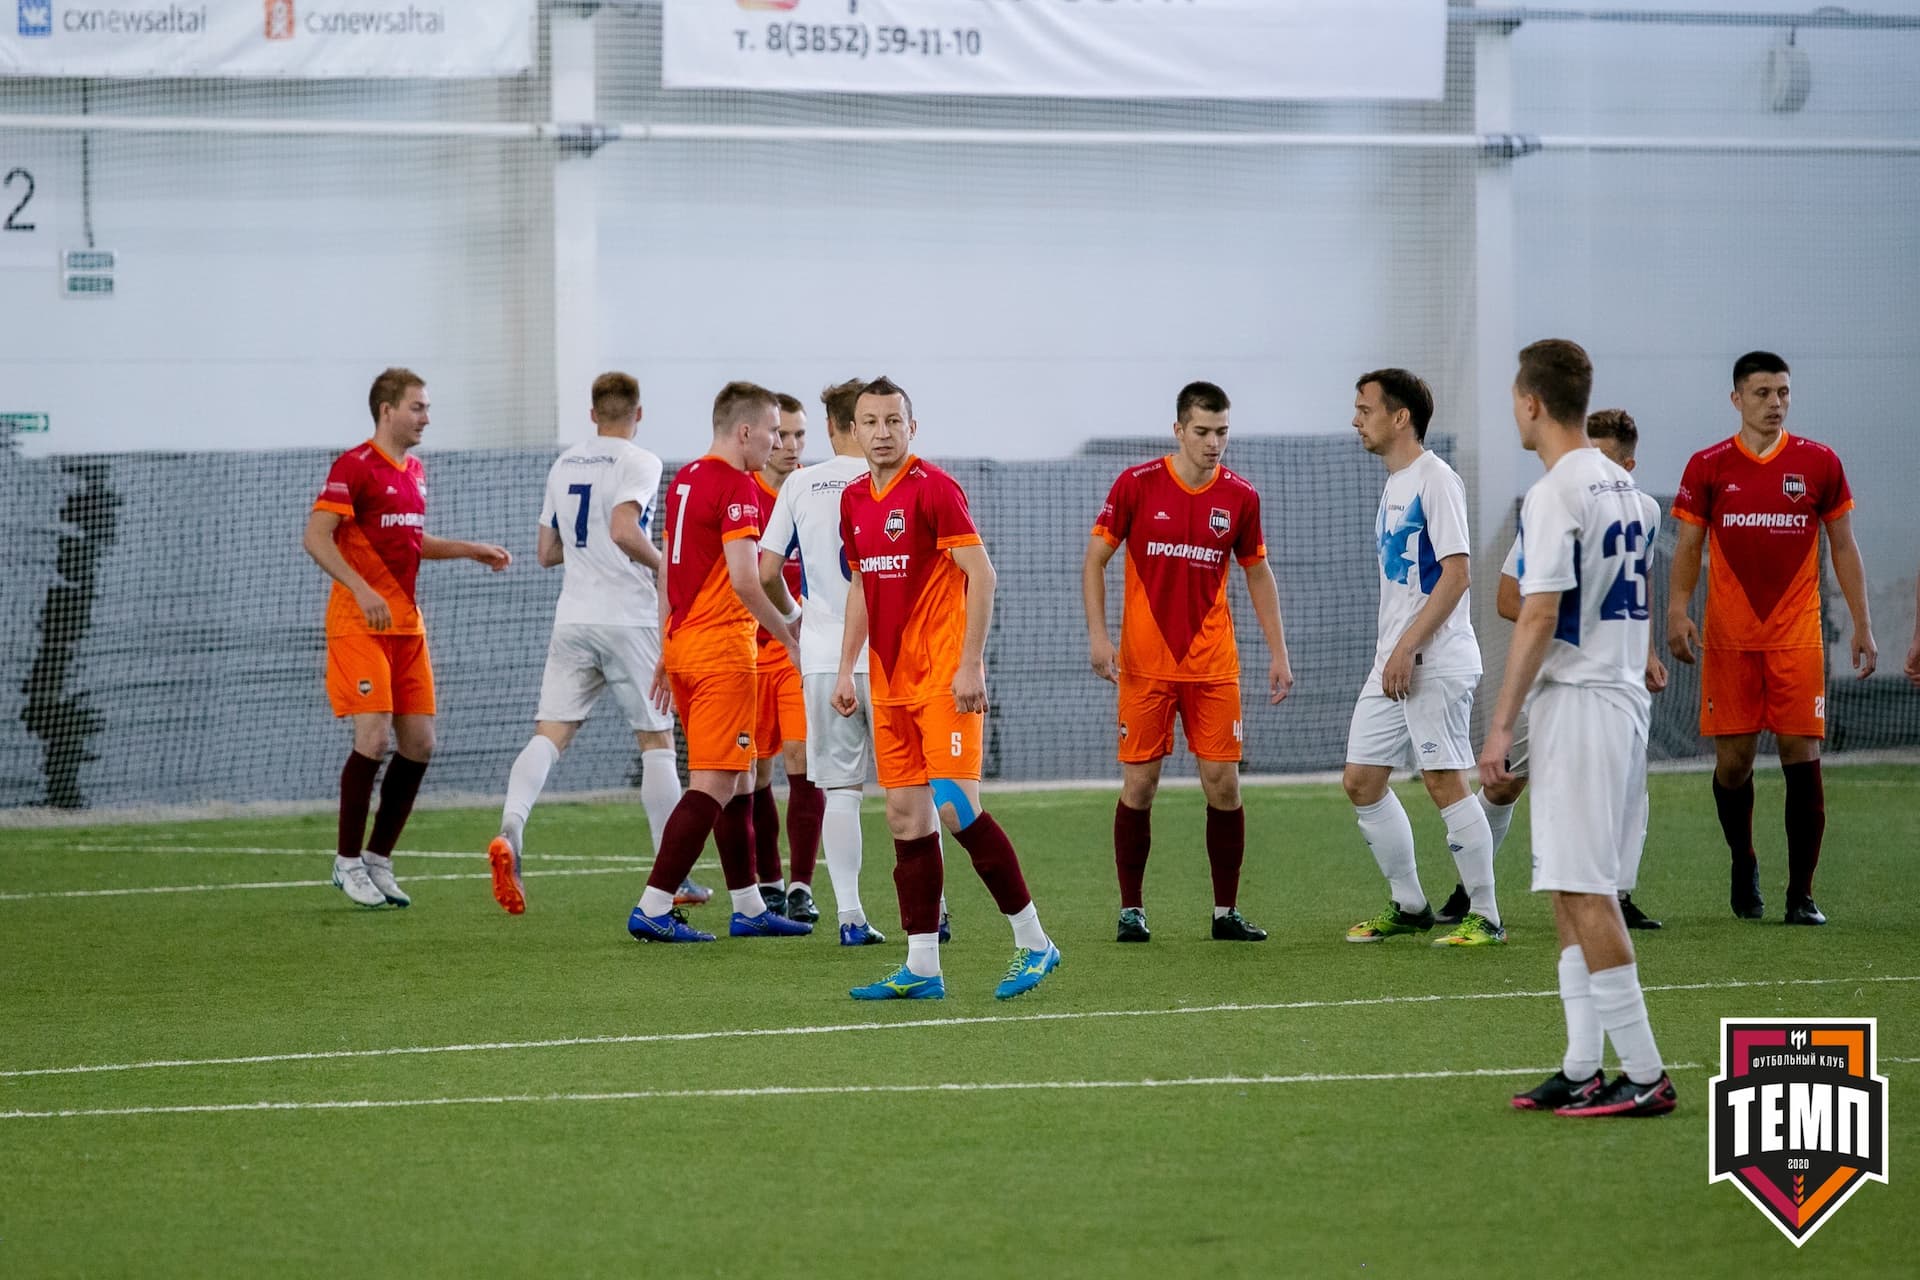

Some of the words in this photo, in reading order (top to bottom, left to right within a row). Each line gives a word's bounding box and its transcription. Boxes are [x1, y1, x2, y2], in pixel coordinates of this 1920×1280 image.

[63, 3, 207, 34] cxnewsaltai
[303, 4, 445, 35] cxnewsaltai
[766, 22, 869, 58] 8(3852)
[877, 26, 981, 55] 59-11-10
[3, 167, 36, 231] 2
[567, 484, 593, 547] 7
[671, 483, 692, 564] 1
[1722, 513, 1809, 529] ПРОДИНВЕСТ
[1146, 541, 1224, 564] ПРОДИНВЕСТ
[1599, 519, 1650, 621] 23
[950, 732, 962, 756] 5
